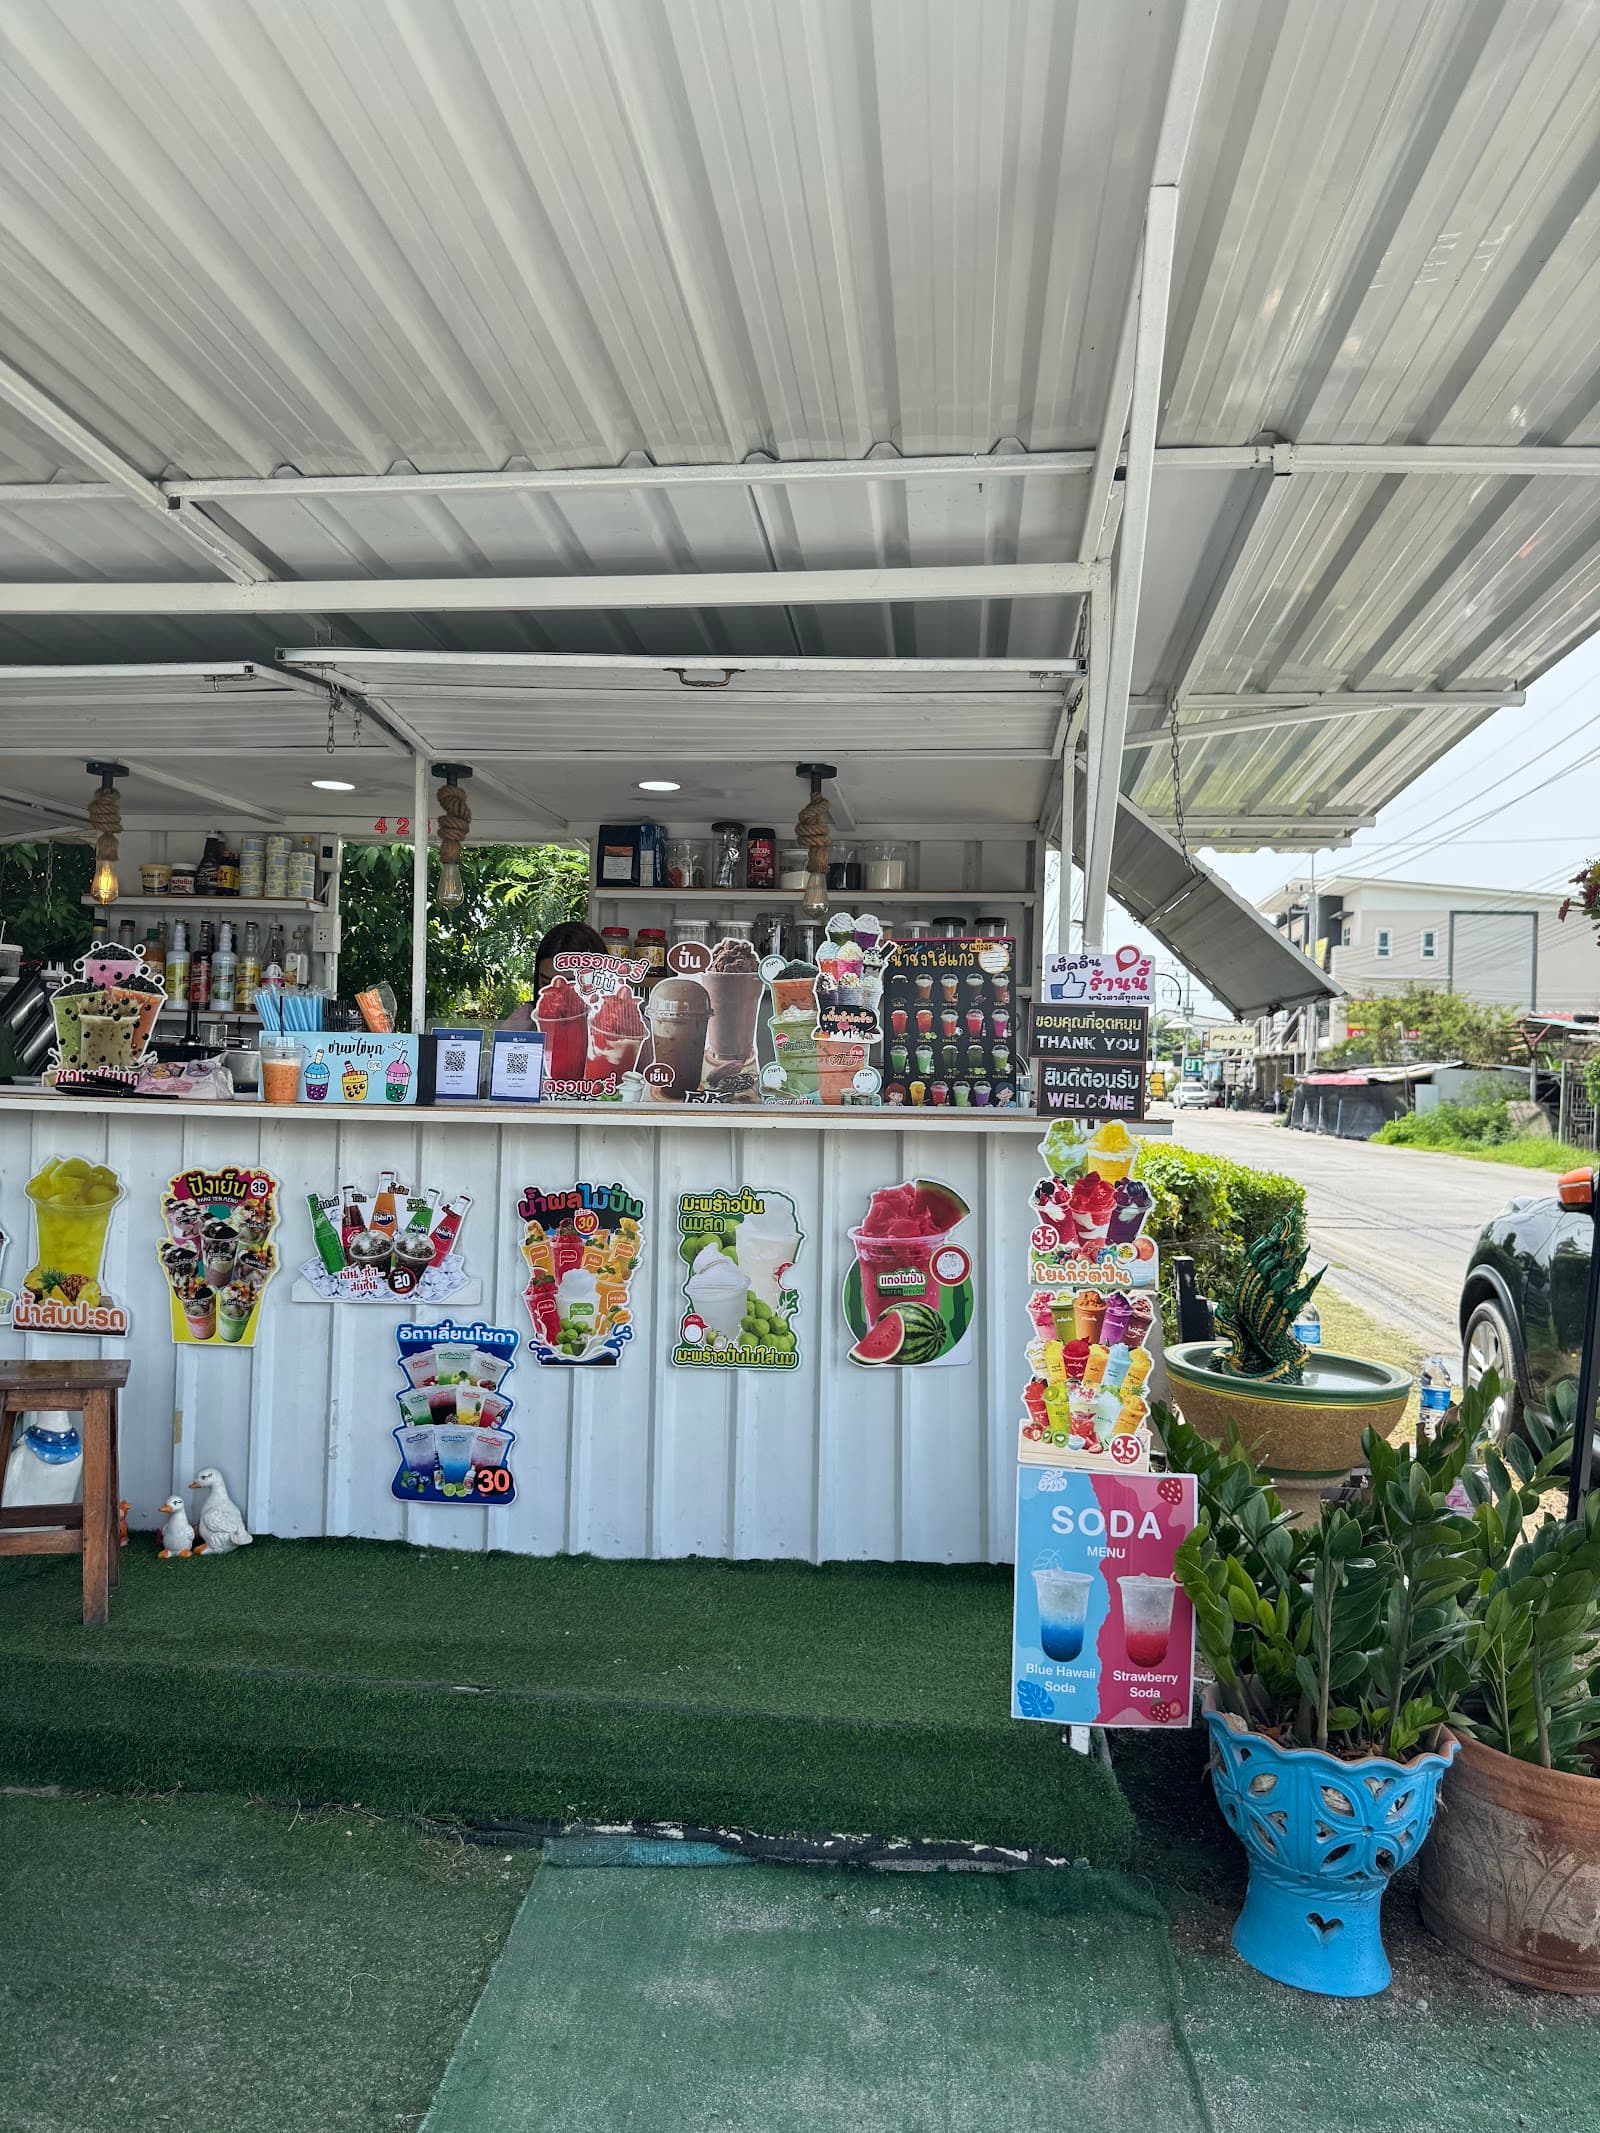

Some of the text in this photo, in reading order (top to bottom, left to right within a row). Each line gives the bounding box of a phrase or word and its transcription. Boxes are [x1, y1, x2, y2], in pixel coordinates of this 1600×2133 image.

[678, 946, 702, 968] ปั่น
[1051, 955, 1102, 973] เช็คอิน
[1089, 959, 1152, 991] ร้านนี้
[1035, 1011, 1142, 1034] ขอบคุณที่อุดหนุน
[1037, 1035, 1140, 1052] THANK YOU
[1185, 1058, 1202, 1072] ยา
[1044, 1066, 1139, 1089] ยินดีต้อนรับ
[1048, 1089, 1135, 1110] WELCOME
[188, 1172, 248, 1198] ปังเย็น
[252, 1182, 267, 1194] 39
[519, 1183, 644, 1218] น้ำผลไม้ปั่น
[682, 1190, 765, 1214] มะพร้าวปั่น
[578, 1217, 594, 1229] 30
[681, 1216, 725, 1231] นมสด
[1033, 1228, 1055, 1246] 35
[1035, 1256, 1131, 1284] โยเกิร์ตปั่น
[393, 1273, 411, 1289] 20
[15, 1292, 125, 1327] น้ำสับปะรด
[400, 1322, 515, 1344] อิตาเลี่ยนโซดา
[677, 1343, 795, 1365] มะพร้าวปั่นไม่ใส่นม
[1113, 1438, 1138, 1458] 35
[477, 1469, 510, 1493] 30
[1051, 1505, 1162, 1541] SODA
[1087, 1545, 1126, 1559] MENU
[1025, 1663, 1096, 1679] Blue Hawaii
[1113, 1670, 1178, 1685] Strawberry
[1044, 1680, 1076, 1694] Soda
[1129, 1686, 1161, 1699] Soda
